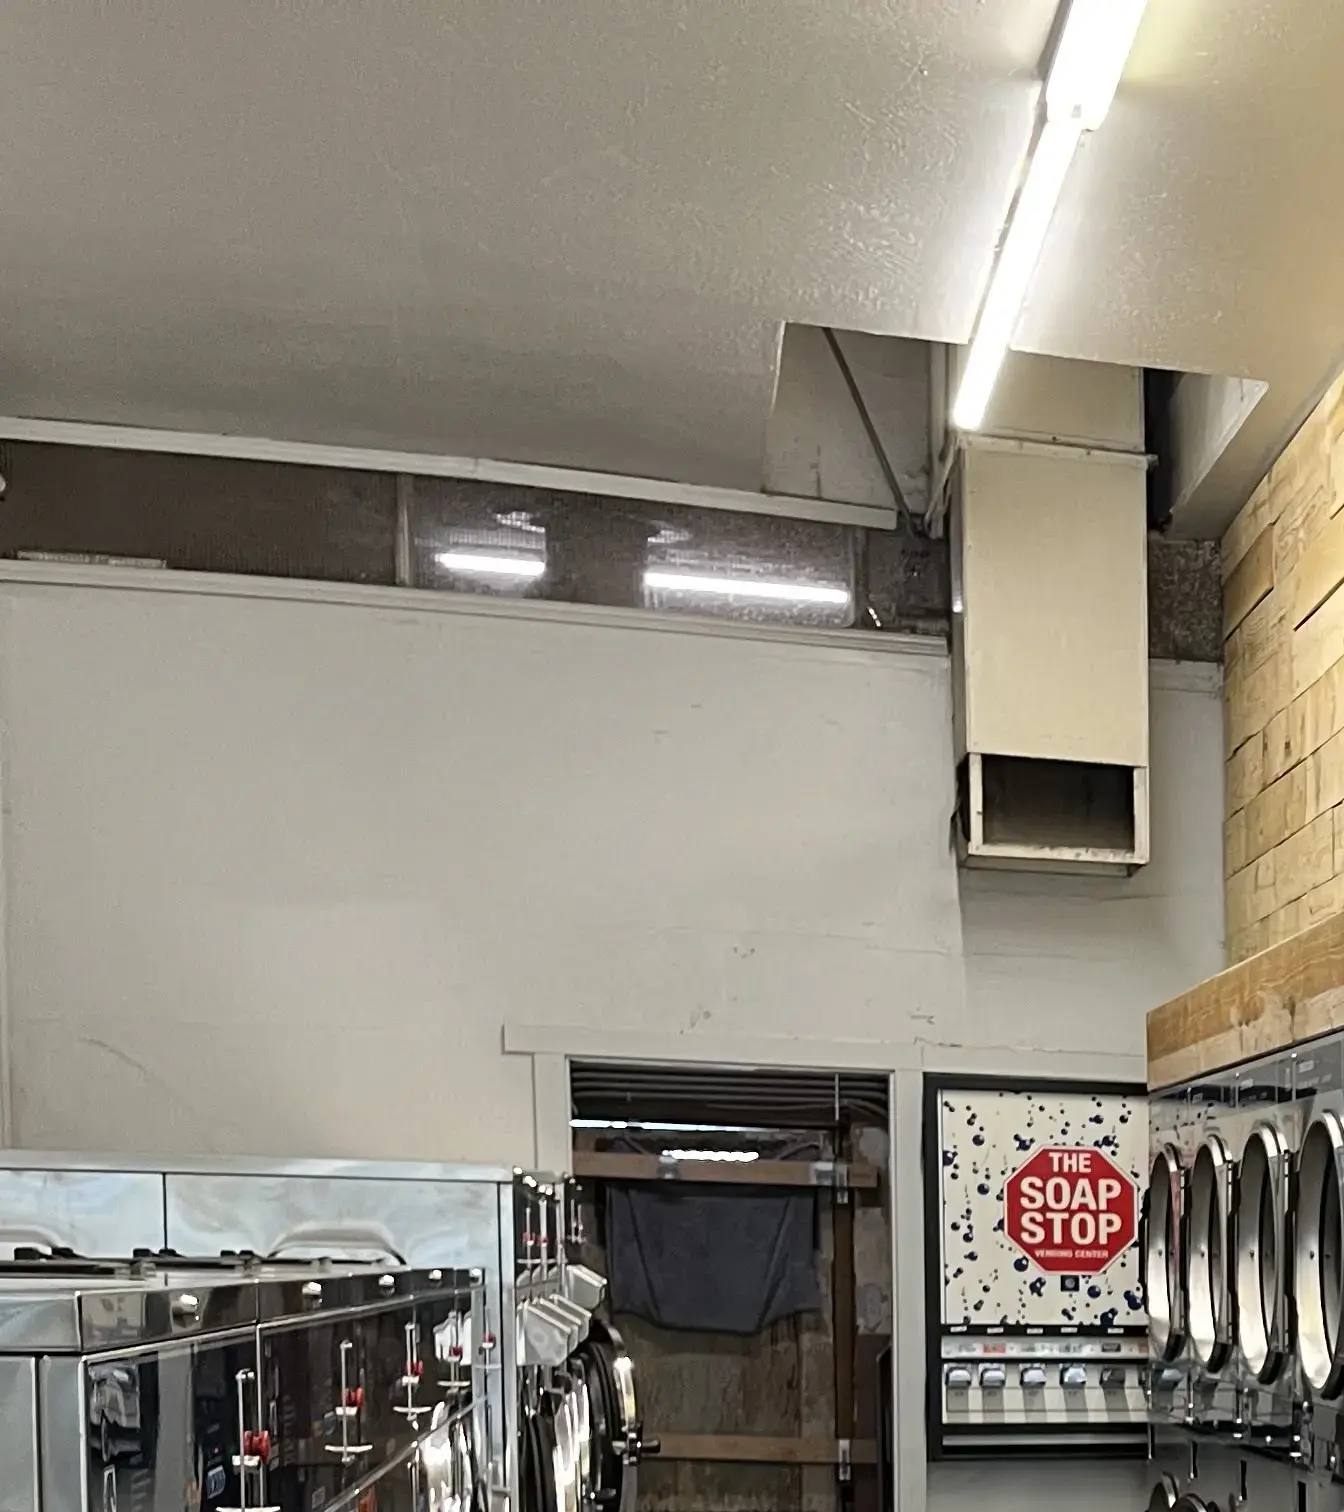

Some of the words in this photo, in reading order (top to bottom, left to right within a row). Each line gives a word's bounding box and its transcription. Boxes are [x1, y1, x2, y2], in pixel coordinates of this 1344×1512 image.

[1048, 1151, 1092, 1173] THE
[1020, 1176, 1122, 1211] SOAP
[1020, 1211, 1122, 1245] STOP
